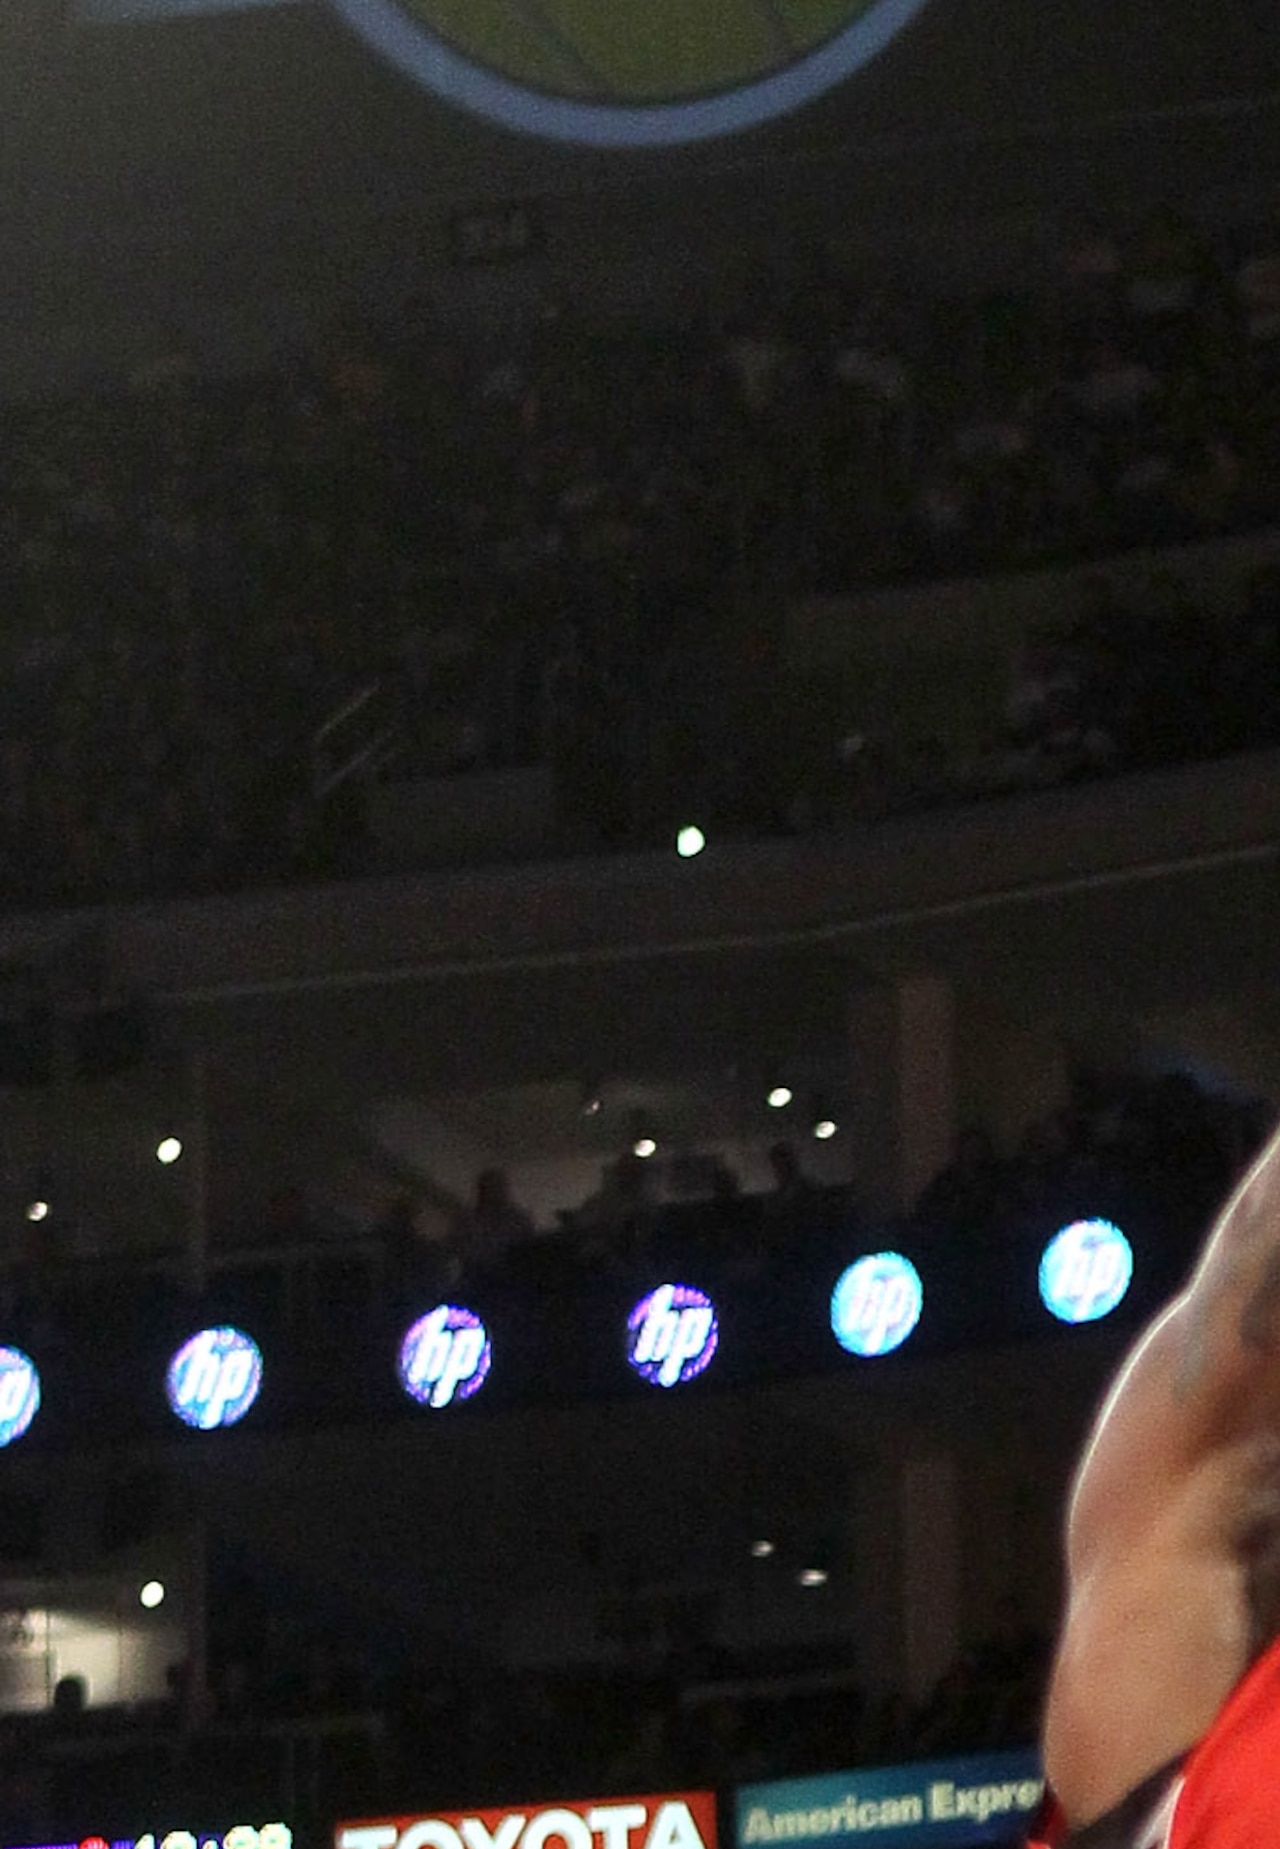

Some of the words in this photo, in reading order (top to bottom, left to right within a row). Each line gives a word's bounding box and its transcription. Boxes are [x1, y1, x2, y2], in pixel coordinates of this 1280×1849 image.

[632, 1284, 715, 1387] hp
[834, 1252, 918, 1356] hp
[172, 1328, 255, 1429] hp
[403, 1304, 487, 1408] hp
[743, 1795, 923, 1844] American
[932, 1780, 1044, 1823] Expre
